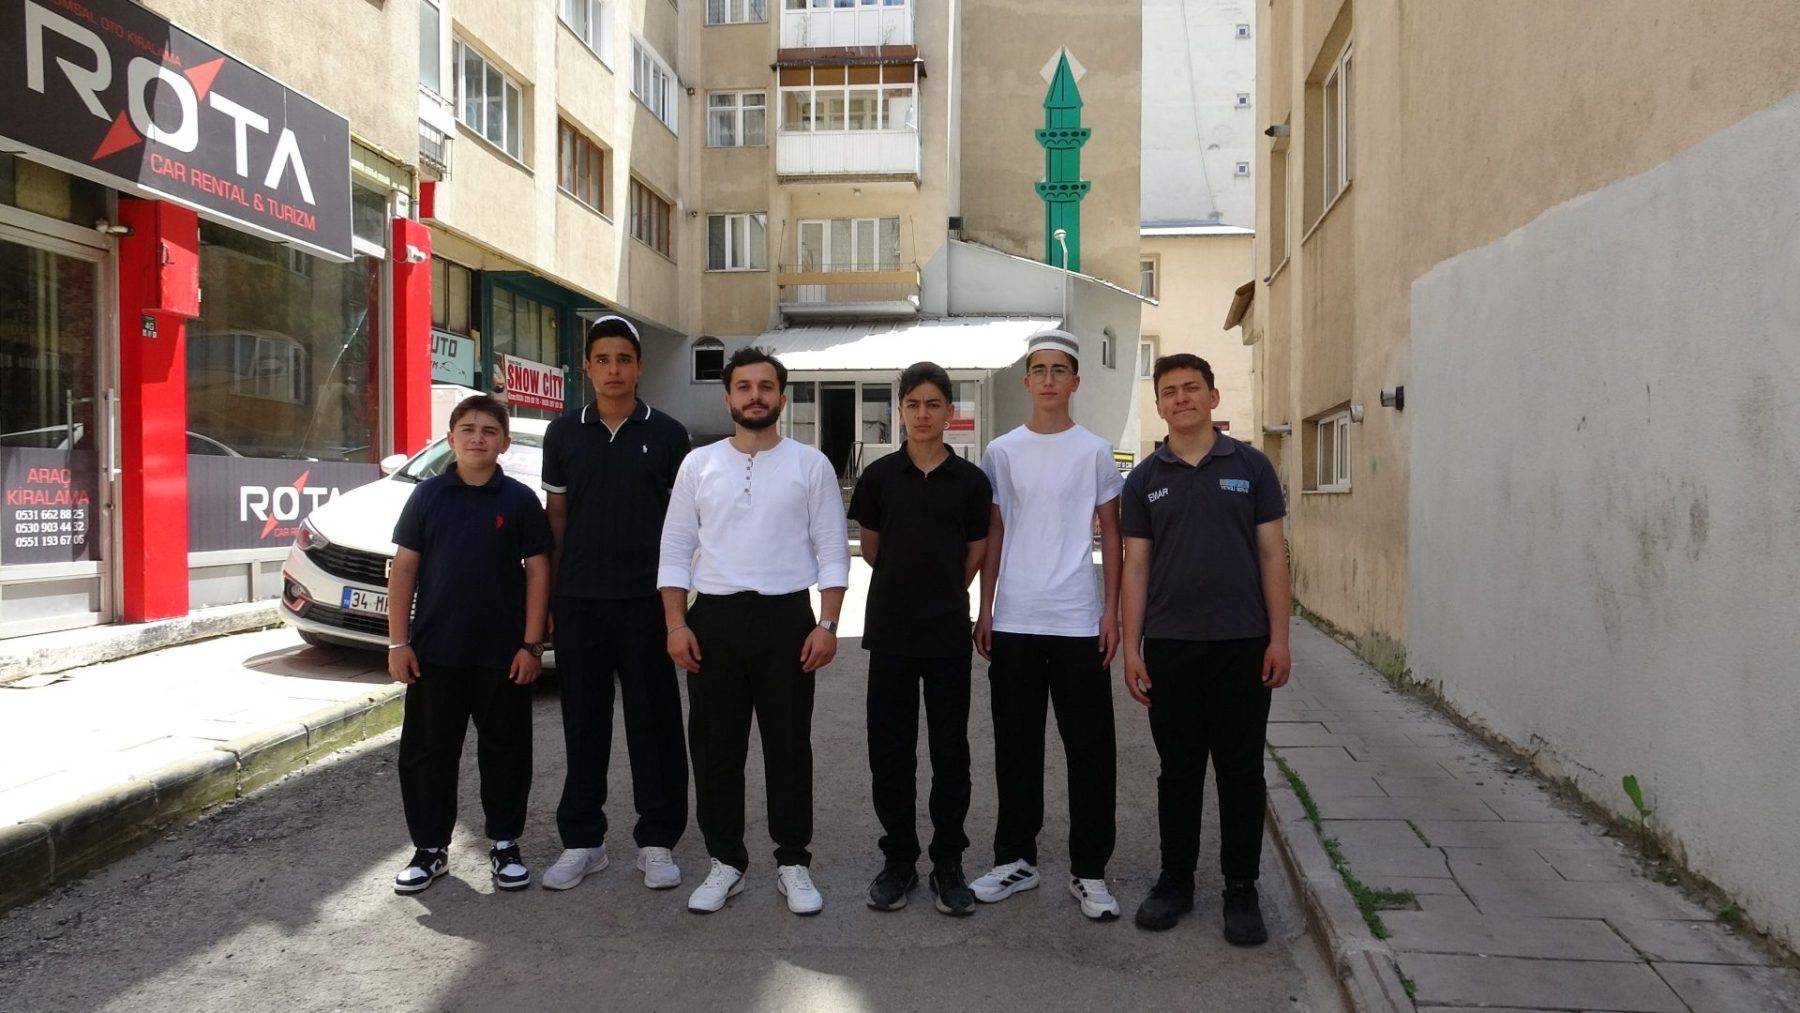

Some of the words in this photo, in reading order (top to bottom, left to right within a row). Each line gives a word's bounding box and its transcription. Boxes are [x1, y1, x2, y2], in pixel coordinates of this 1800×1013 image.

[25, 0, 316, 206] ROTA
[150, 153, 186, 182] CAR
[190, 168, 249, 207] RENTAL
[253, 193, 265, 212] &
[267, 197, 317, 231] TURİZM
[507, 364, 539, 393] SNOW
[27, 467, 72, 488] ARAÇ
[6, 486, 91, 505] KİRALAMA
[240, 485, 341, 522] ROT
[15, 509, 39, 520] 0531
[41, 509, 59, 520] 662
[60, 509, 72, 519] 88
[15, 523, 40, 534] 0530
[41, 522, 59, 532] 903
[60, 521, 72, 532] 44
[15, 536, 39, 548] 0551
[42, 535, 59, 546] 193
[60, 534, 72, 545] 67
[351, 591, 368, 609] 34
